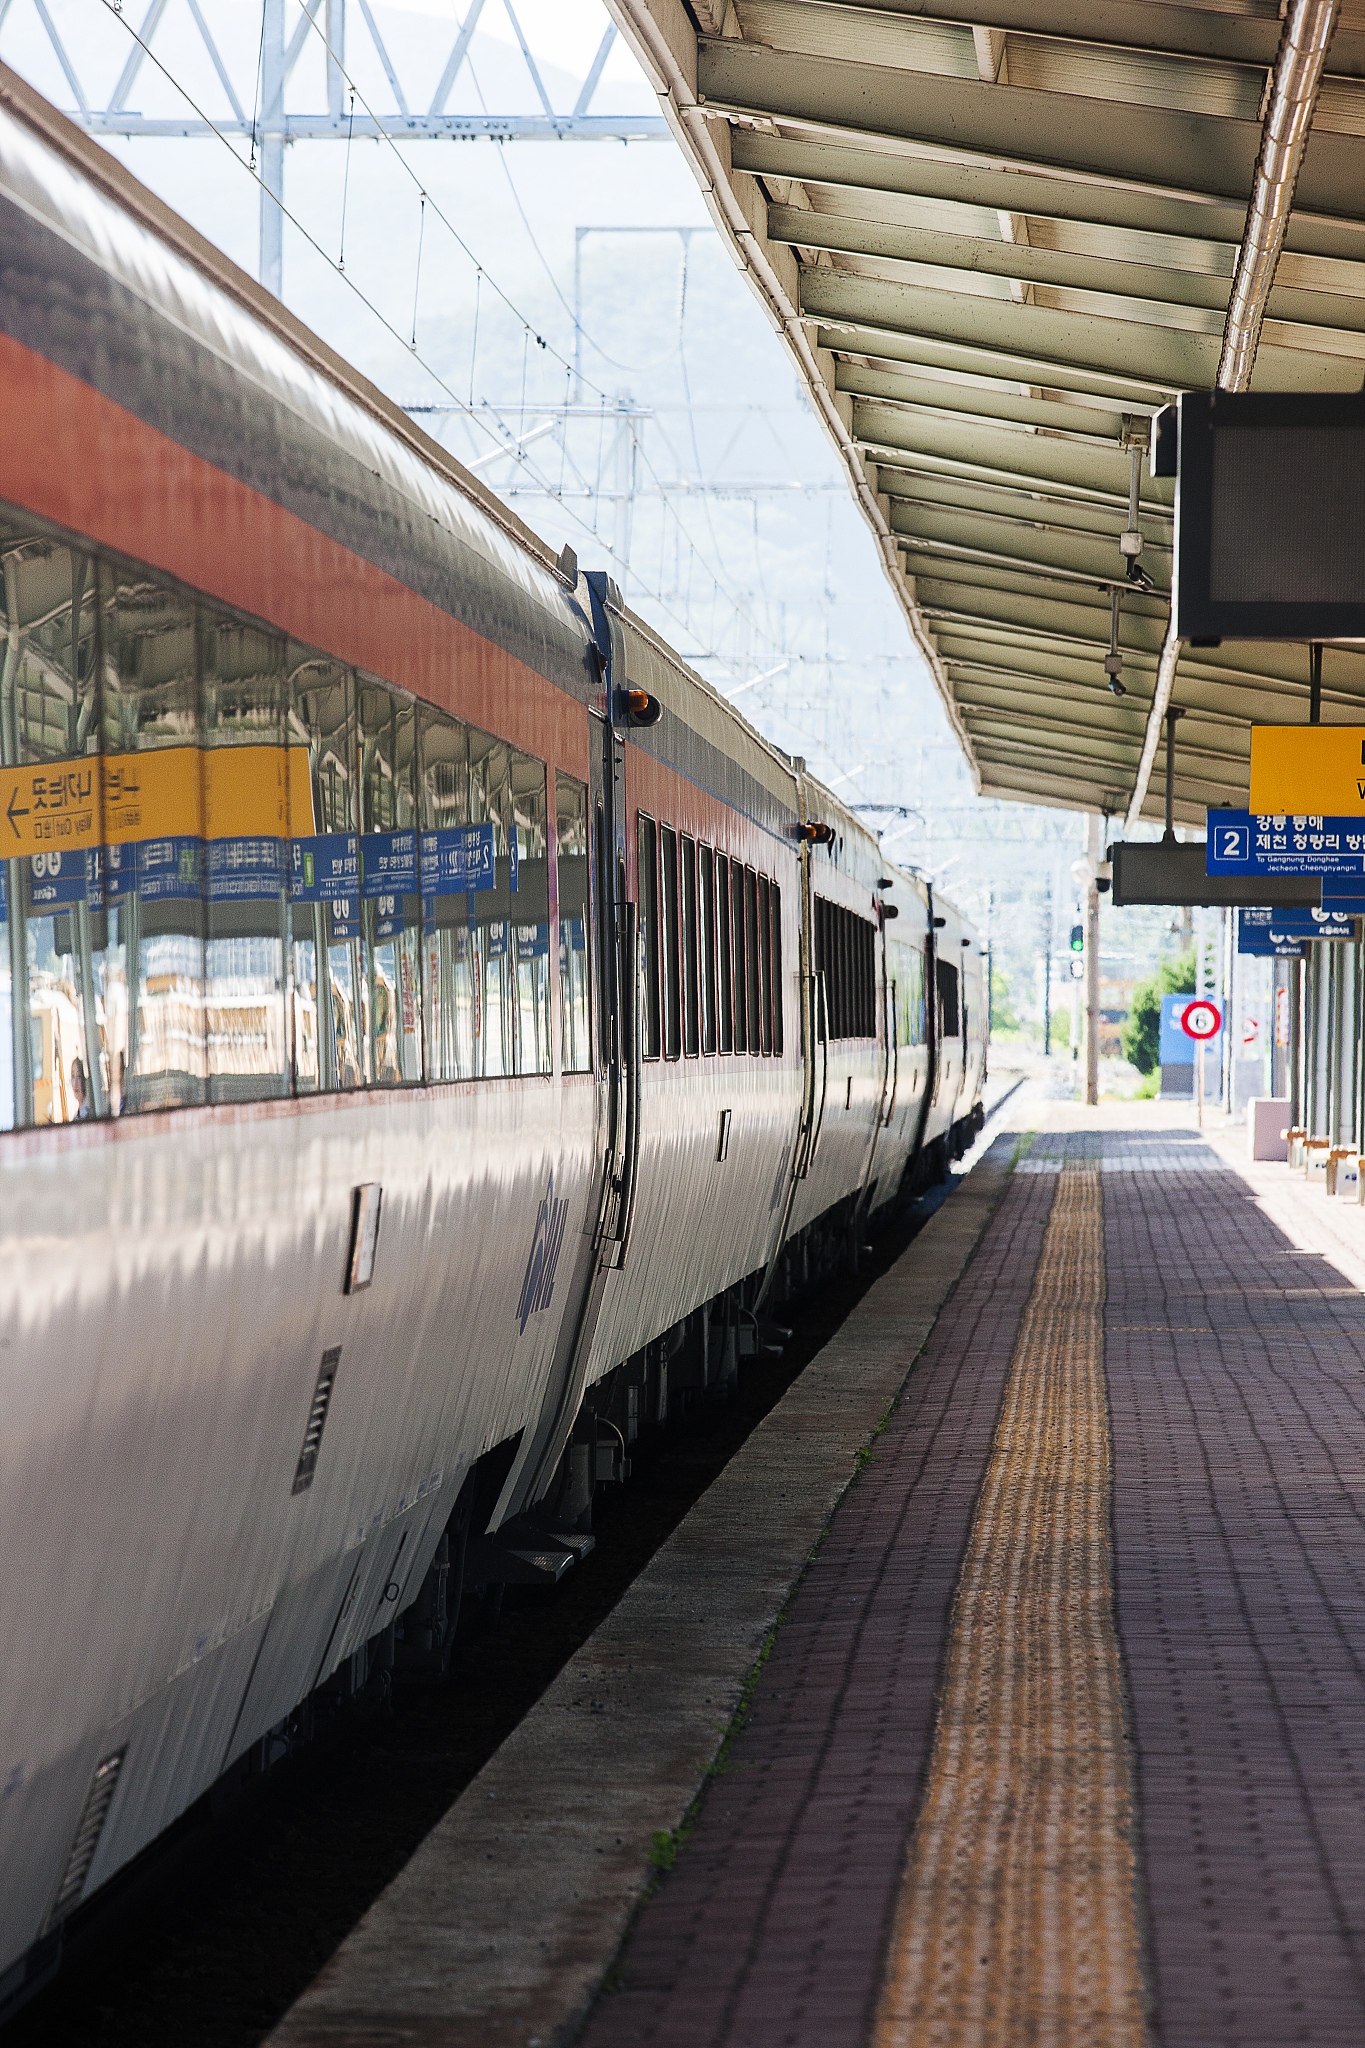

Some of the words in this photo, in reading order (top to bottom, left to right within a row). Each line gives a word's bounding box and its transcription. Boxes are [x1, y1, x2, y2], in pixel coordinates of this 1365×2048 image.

[1223, 831, 1240, 856] 2
[1255, 834, 1287, 850] 제천
[1292, 834, 1340, 850] 청량리
[1346, 834, 1365, 850] 방
[1307, 856, 1340, 864] Donghae
[1267, 864, 1298, 872] Jecheon
